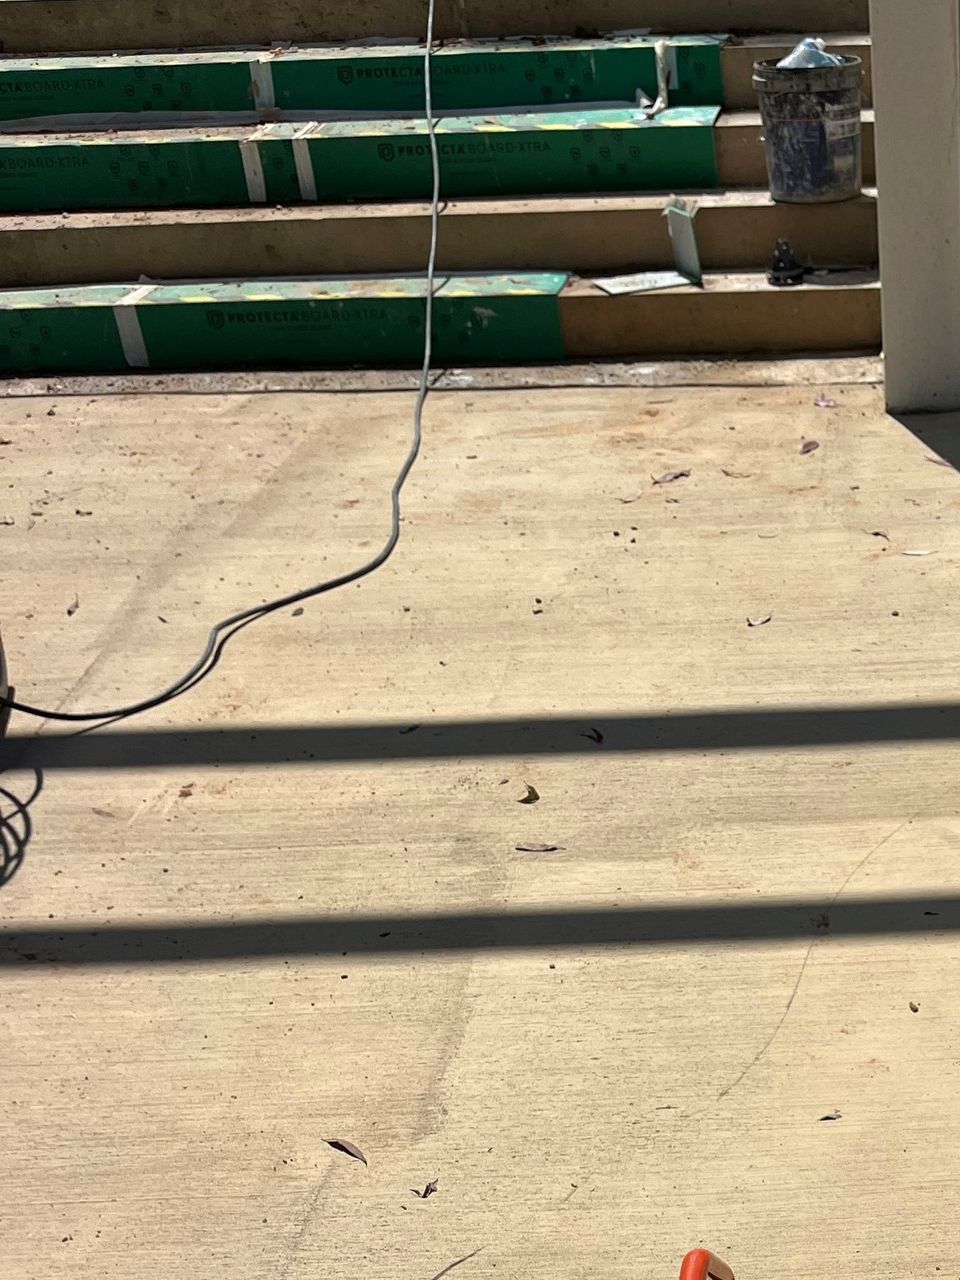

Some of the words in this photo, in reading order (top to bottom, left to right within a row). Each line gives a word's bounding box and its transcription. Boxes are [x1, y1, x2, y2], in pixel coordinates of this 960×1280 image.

[357, 67, 423, 80] PROTECTA
[430, 63, 507, 77] OARD-XTRA
[398, 144, 465, 157] PROTCTA
[228, 311, 299, 323] PROTECTA
